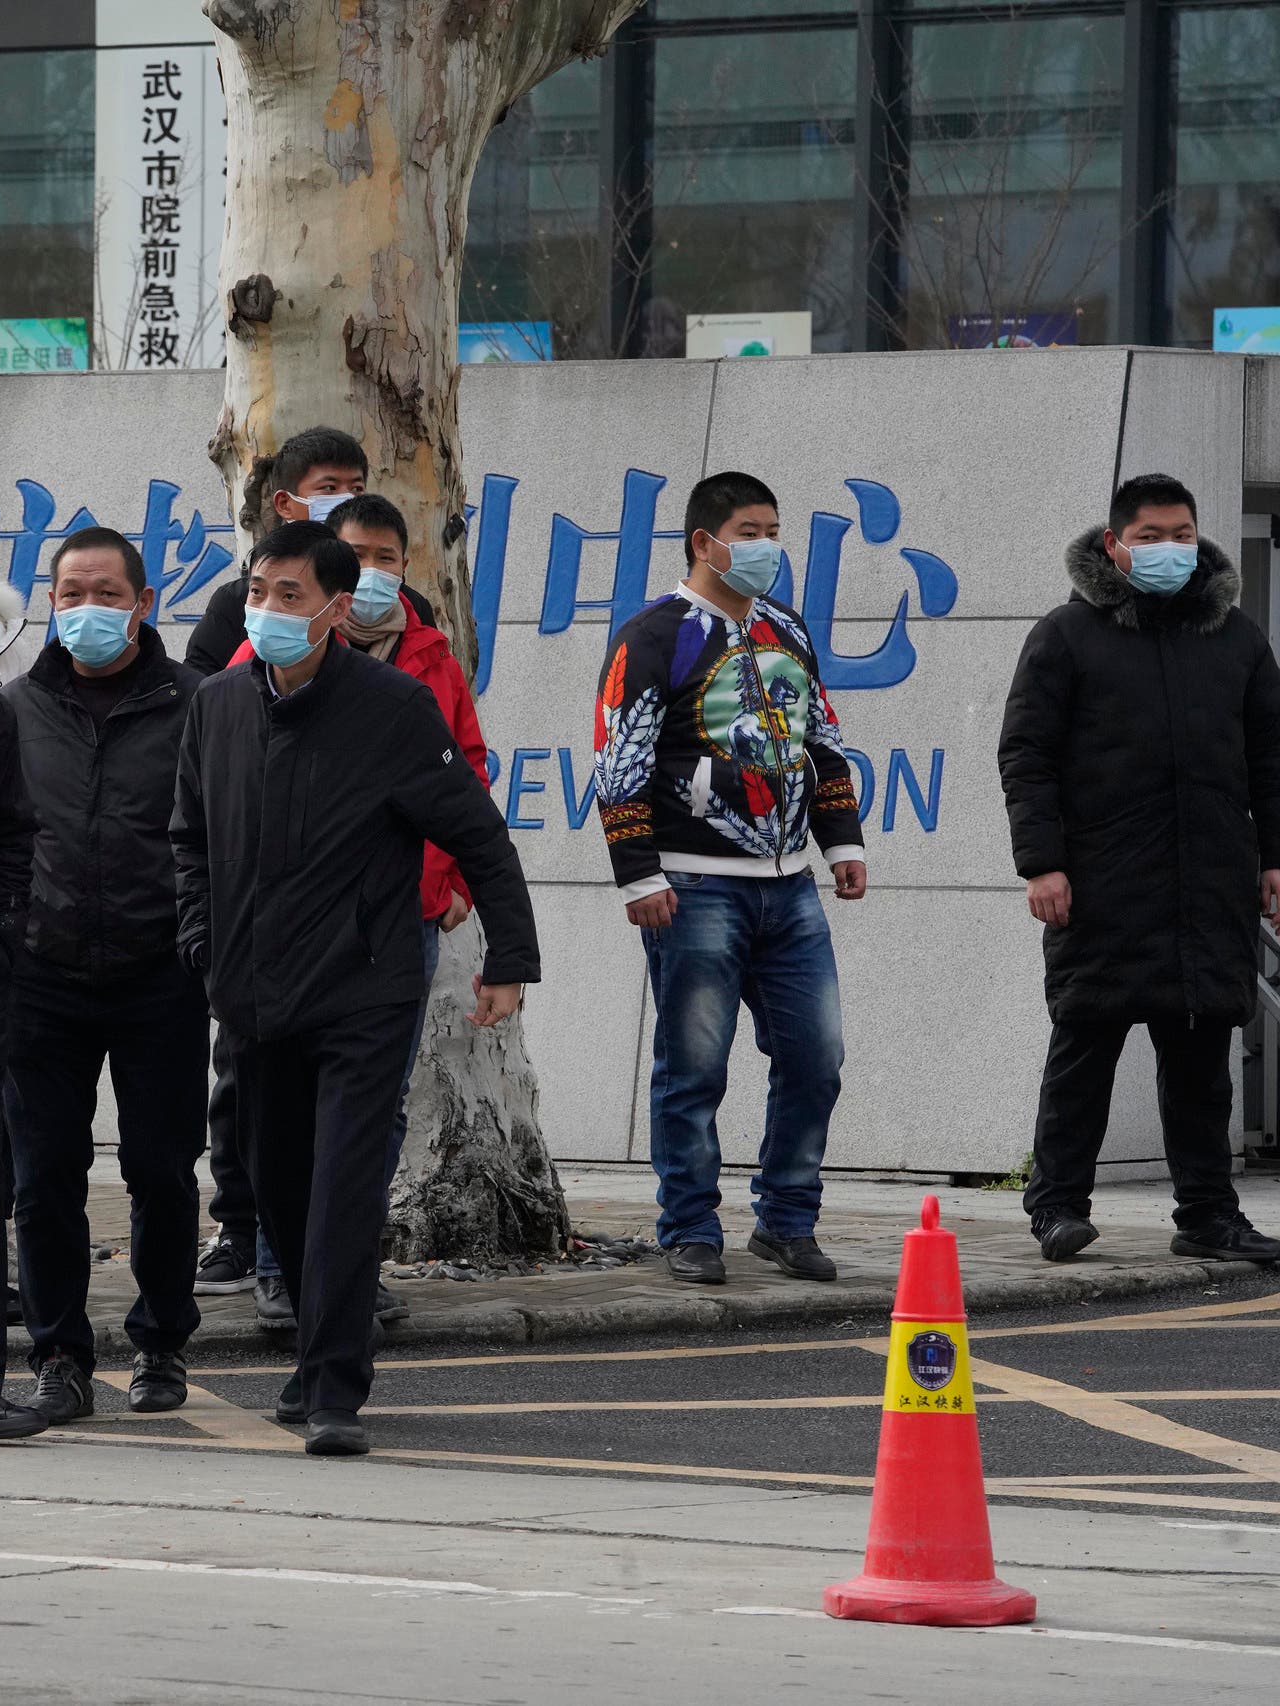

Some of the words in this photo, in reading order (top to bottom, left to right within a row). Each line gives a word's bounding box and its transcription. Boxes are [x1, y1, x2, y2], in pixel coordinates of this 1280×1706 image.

[139, 60, 182, 367] 武汉市院前急救
